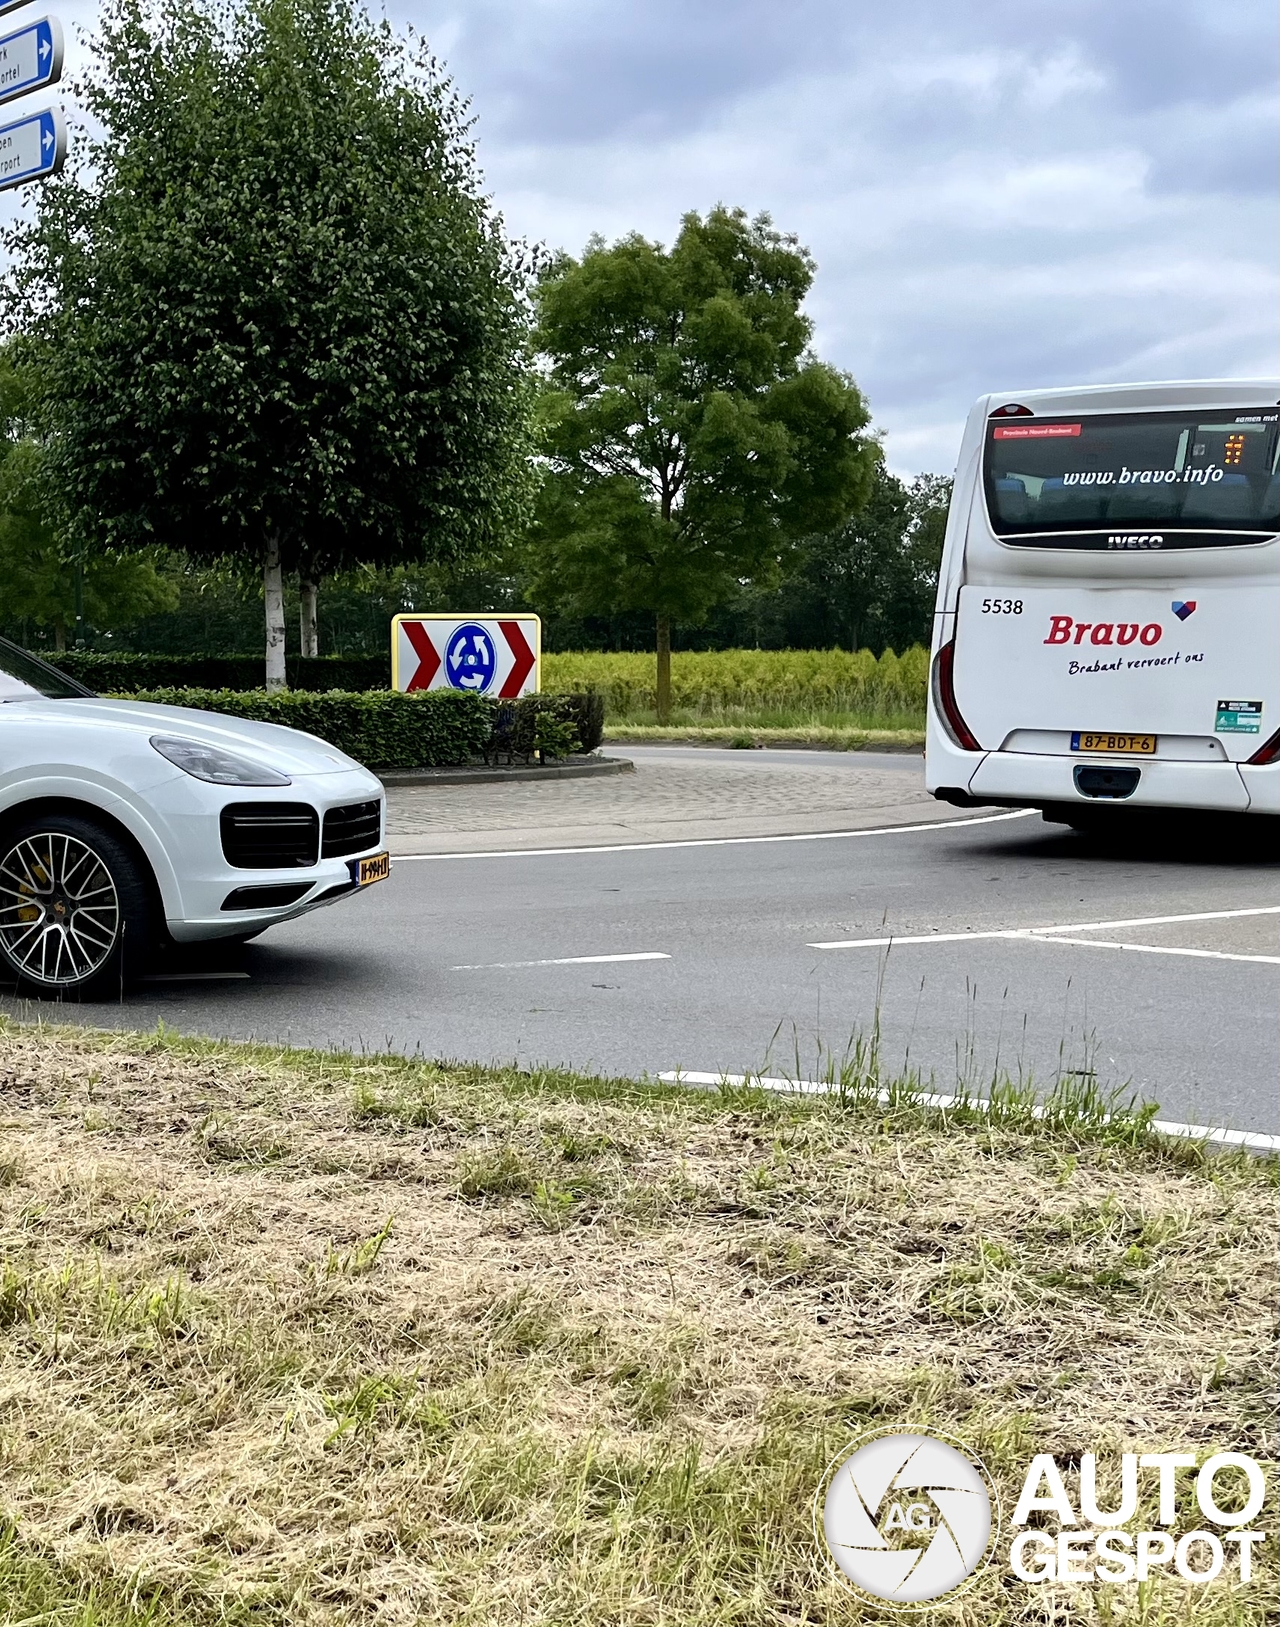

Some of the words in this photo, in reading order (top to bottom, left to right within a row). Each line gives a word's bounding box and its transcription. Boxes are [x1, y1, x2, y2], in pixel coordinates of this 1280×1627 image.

[1262, 414, 1279, 422] met
[1063, 464, 1224, 486] www.bravo.info
[1107, 535, 1164, 549] IVECO
[981, 598, 1024, 615] 5538
[1043, 615, 1163, 646] Bravo
[1068, 657, 1123, 675] Brabant
[1127, 651, 1181, 669] vervoert
[1185, 652, 1205, 663] ons
[1084, 735, 1150, 750] 87-BDT-6
